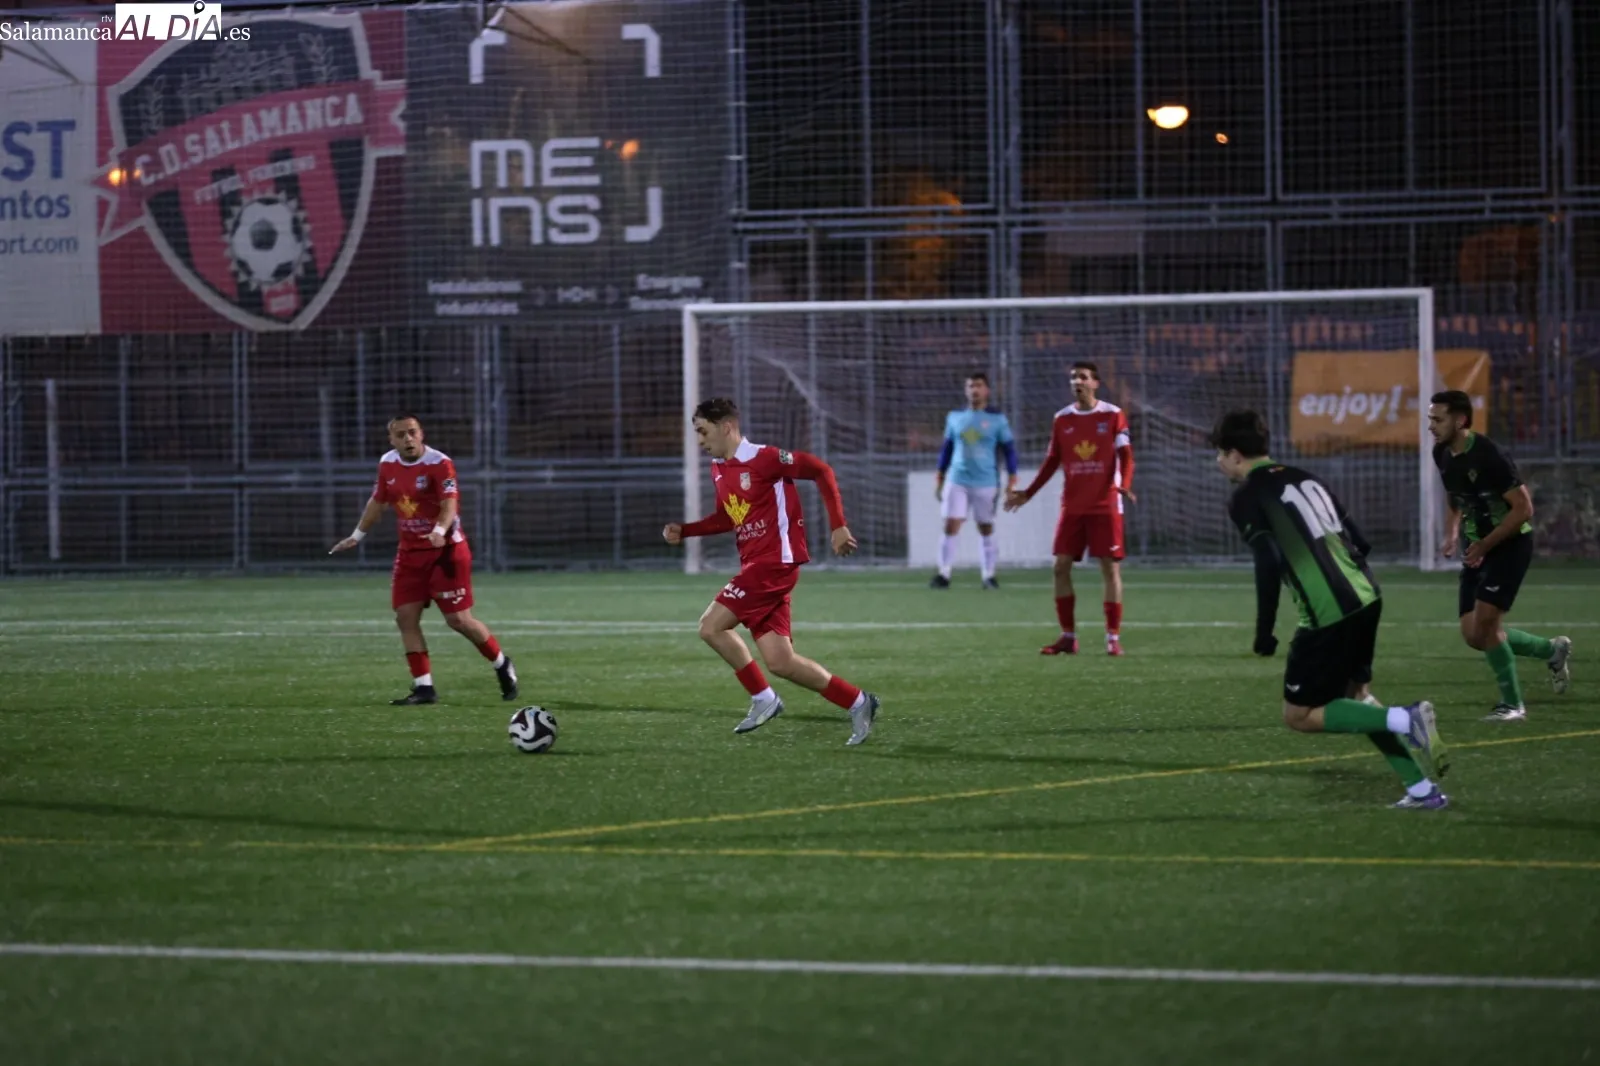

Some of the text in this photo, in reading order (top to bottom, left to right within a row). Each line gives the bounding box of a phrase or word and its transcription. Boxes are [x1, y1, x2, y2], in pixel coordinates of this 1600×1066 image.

[470, 137, 600, 189] ME
[1299, 384, 1405, 425] enjoy!
[1280, 478, 1343, 540] 10
